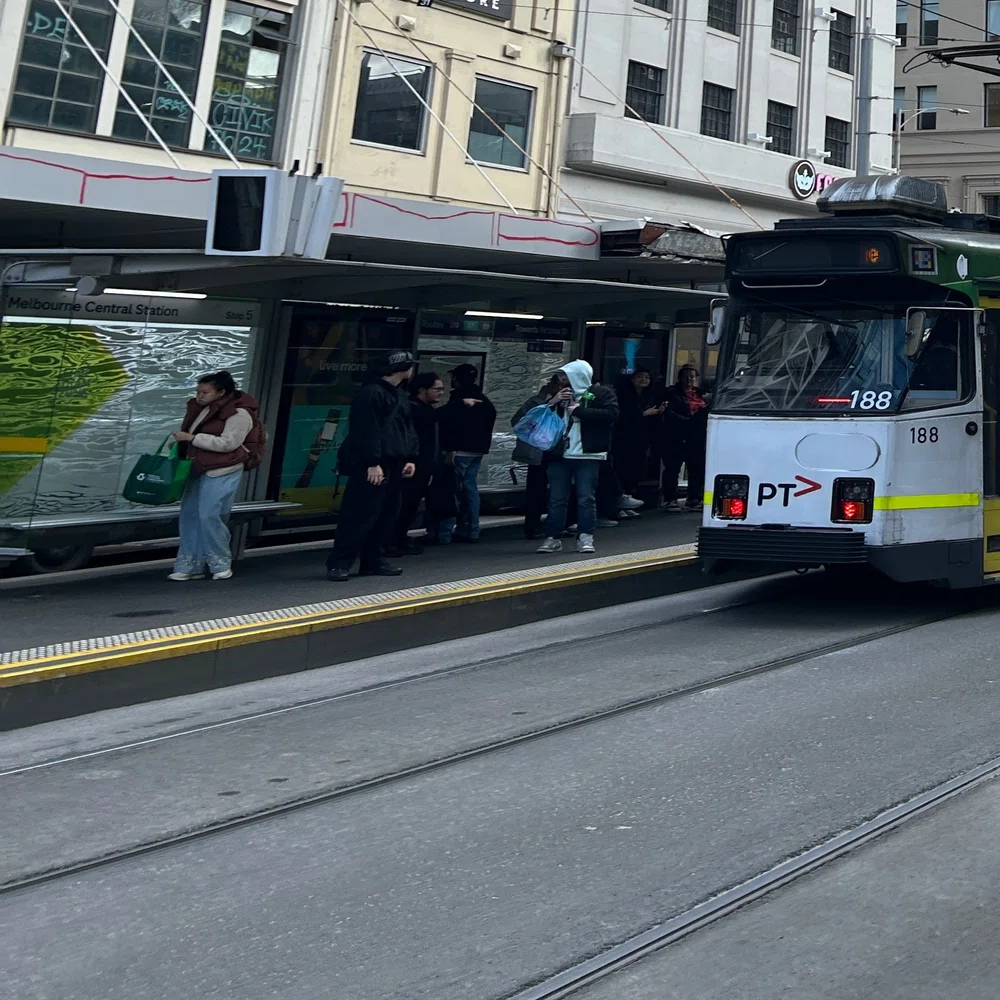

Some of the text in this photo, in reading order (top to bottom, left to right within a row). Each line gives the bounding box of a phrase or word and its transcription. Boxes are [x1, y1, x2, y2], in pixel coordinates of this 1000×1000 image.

[7, 298, 253, 321] Melbourne Central Station Stop 5
[340, 362, 368, 372] more
[850, 390, 892, 410] 188
[910, 427, 939, 444] 188
